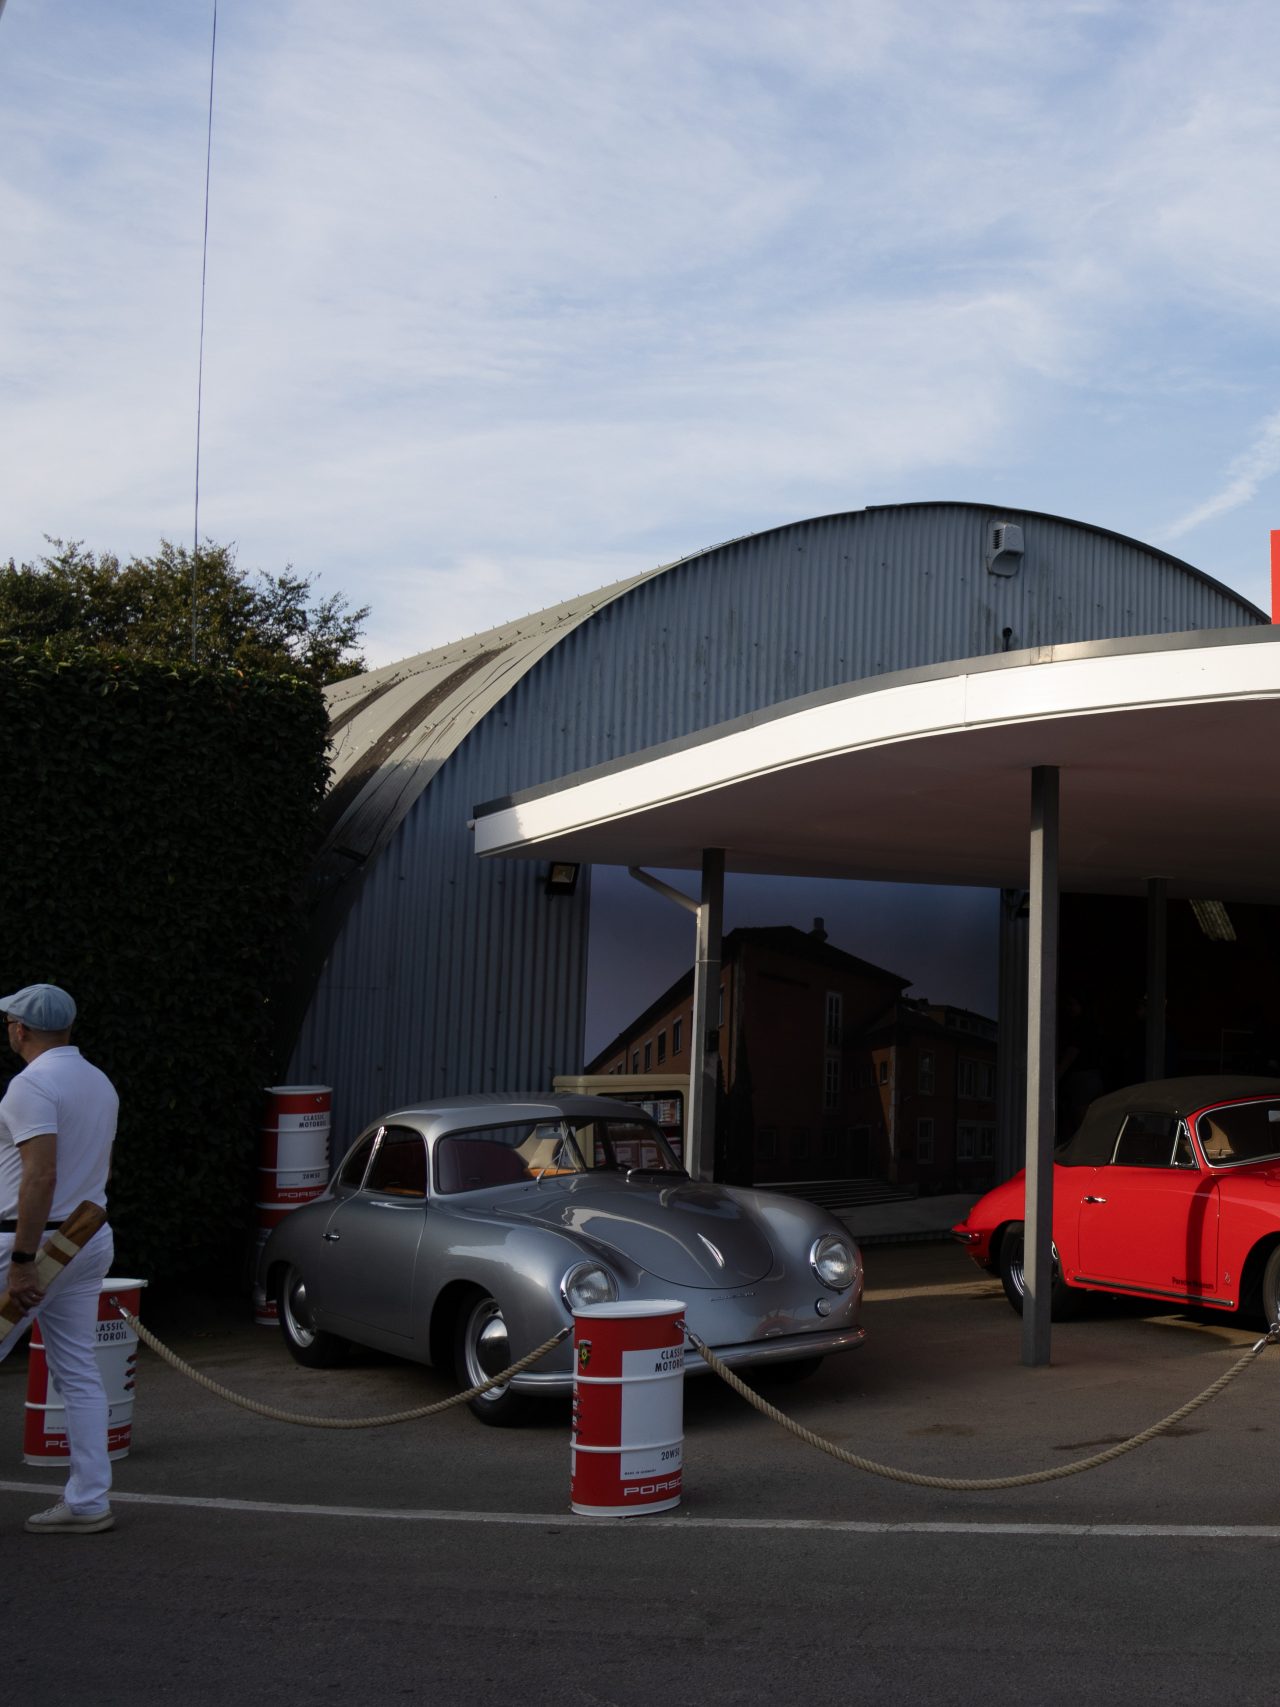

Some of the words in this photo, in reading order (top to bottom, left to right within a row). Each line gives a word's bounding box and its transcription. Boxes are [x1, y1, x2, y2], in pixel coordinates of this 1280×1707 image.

[95, 1321, 124, 1333] LASSIC
[97, 1330, 127, 1342] TOROIL
[660, 1447, 680, 1461] 20W50
